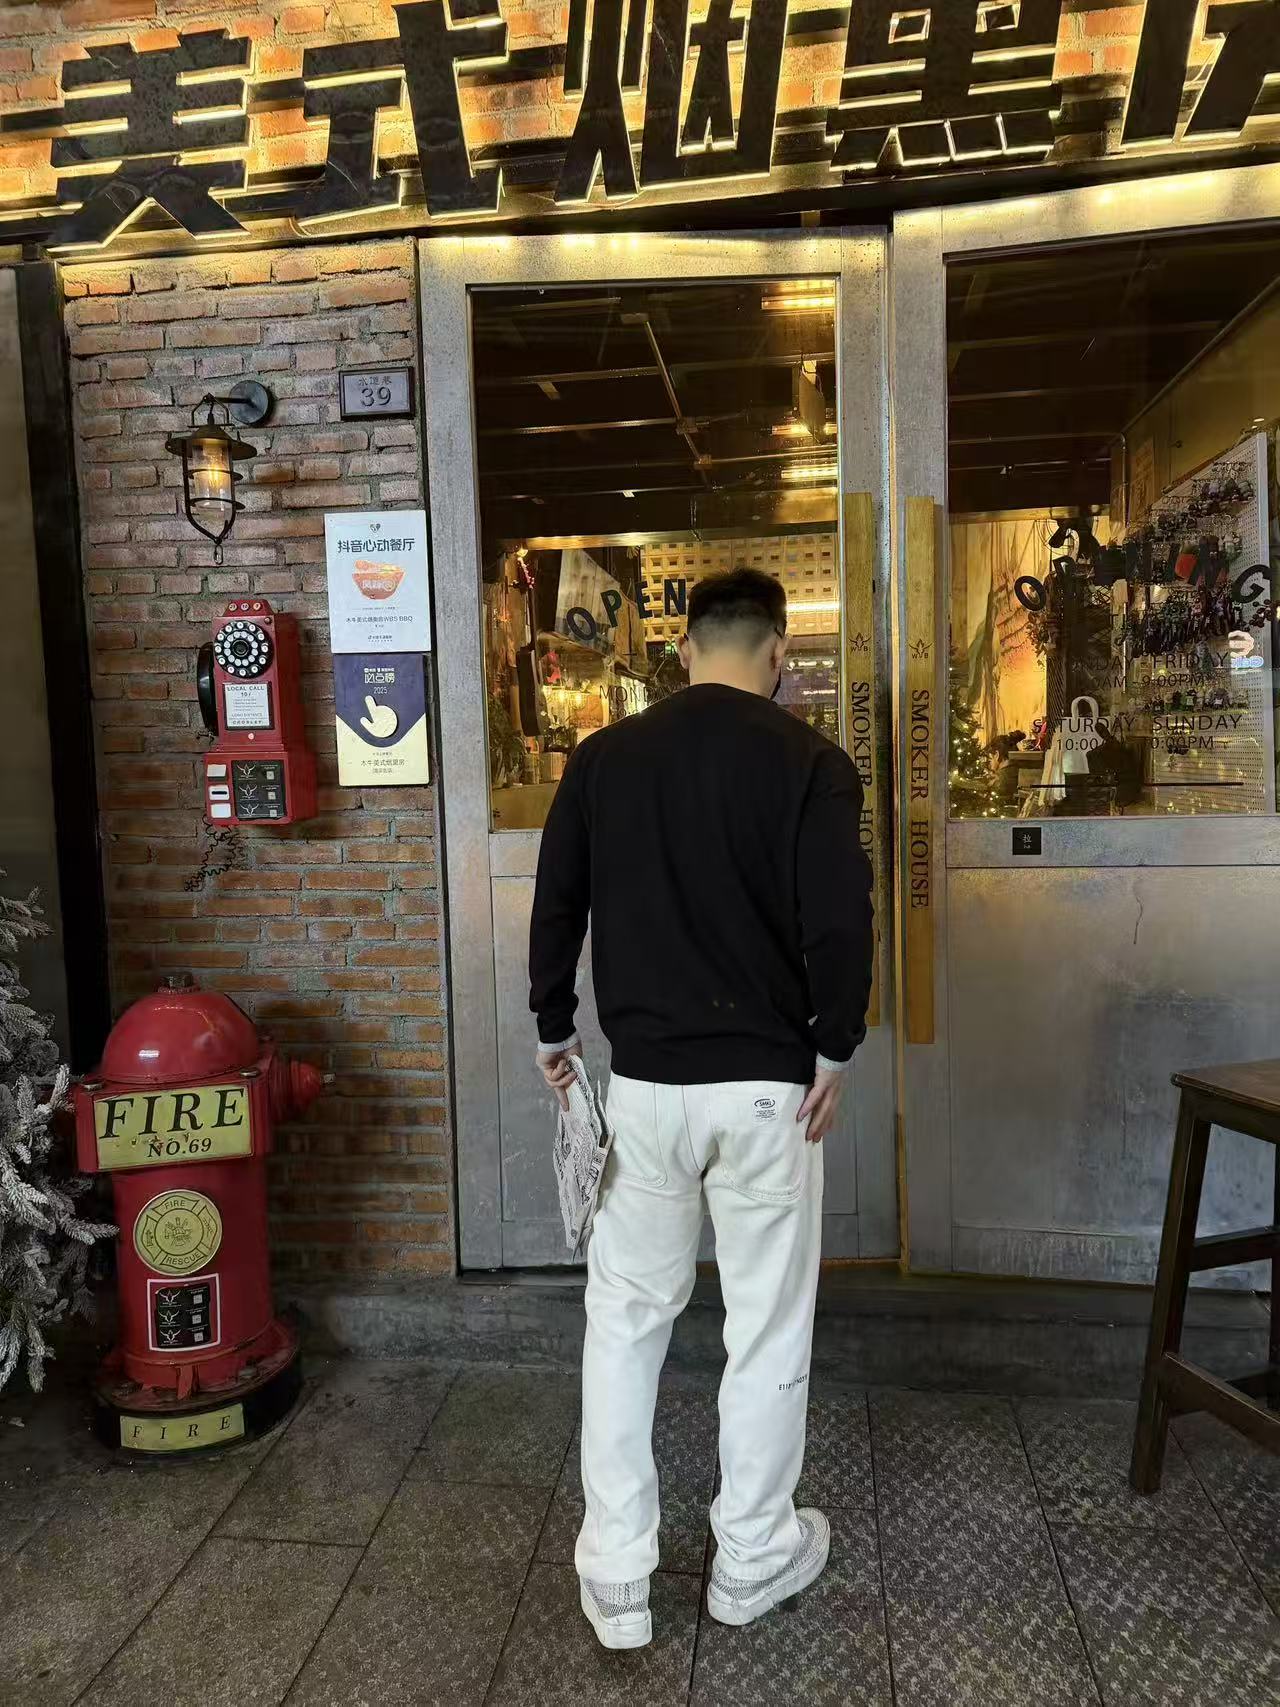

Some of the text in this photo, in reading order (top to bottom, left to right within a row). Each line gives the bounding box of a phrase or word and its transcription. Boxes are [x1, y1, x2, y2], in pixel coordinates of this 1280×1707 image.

[362, 387, 391, 406] 39
[338, 538, 415, 553] 抖音心动餐厅
[1152, 714, 1243, 731] SUNDAY
[910, 690, 930, 908] SMOKER HOUSE
[98, 1088, 245, 1140] FIRE
[147, 1137, 212, 1158] NO.69
[164, 1200, 186, 1210] FIRE
[166, 1252, 201, 1265] RESCUE
[132, 1415, 231, 1440] FIRE
